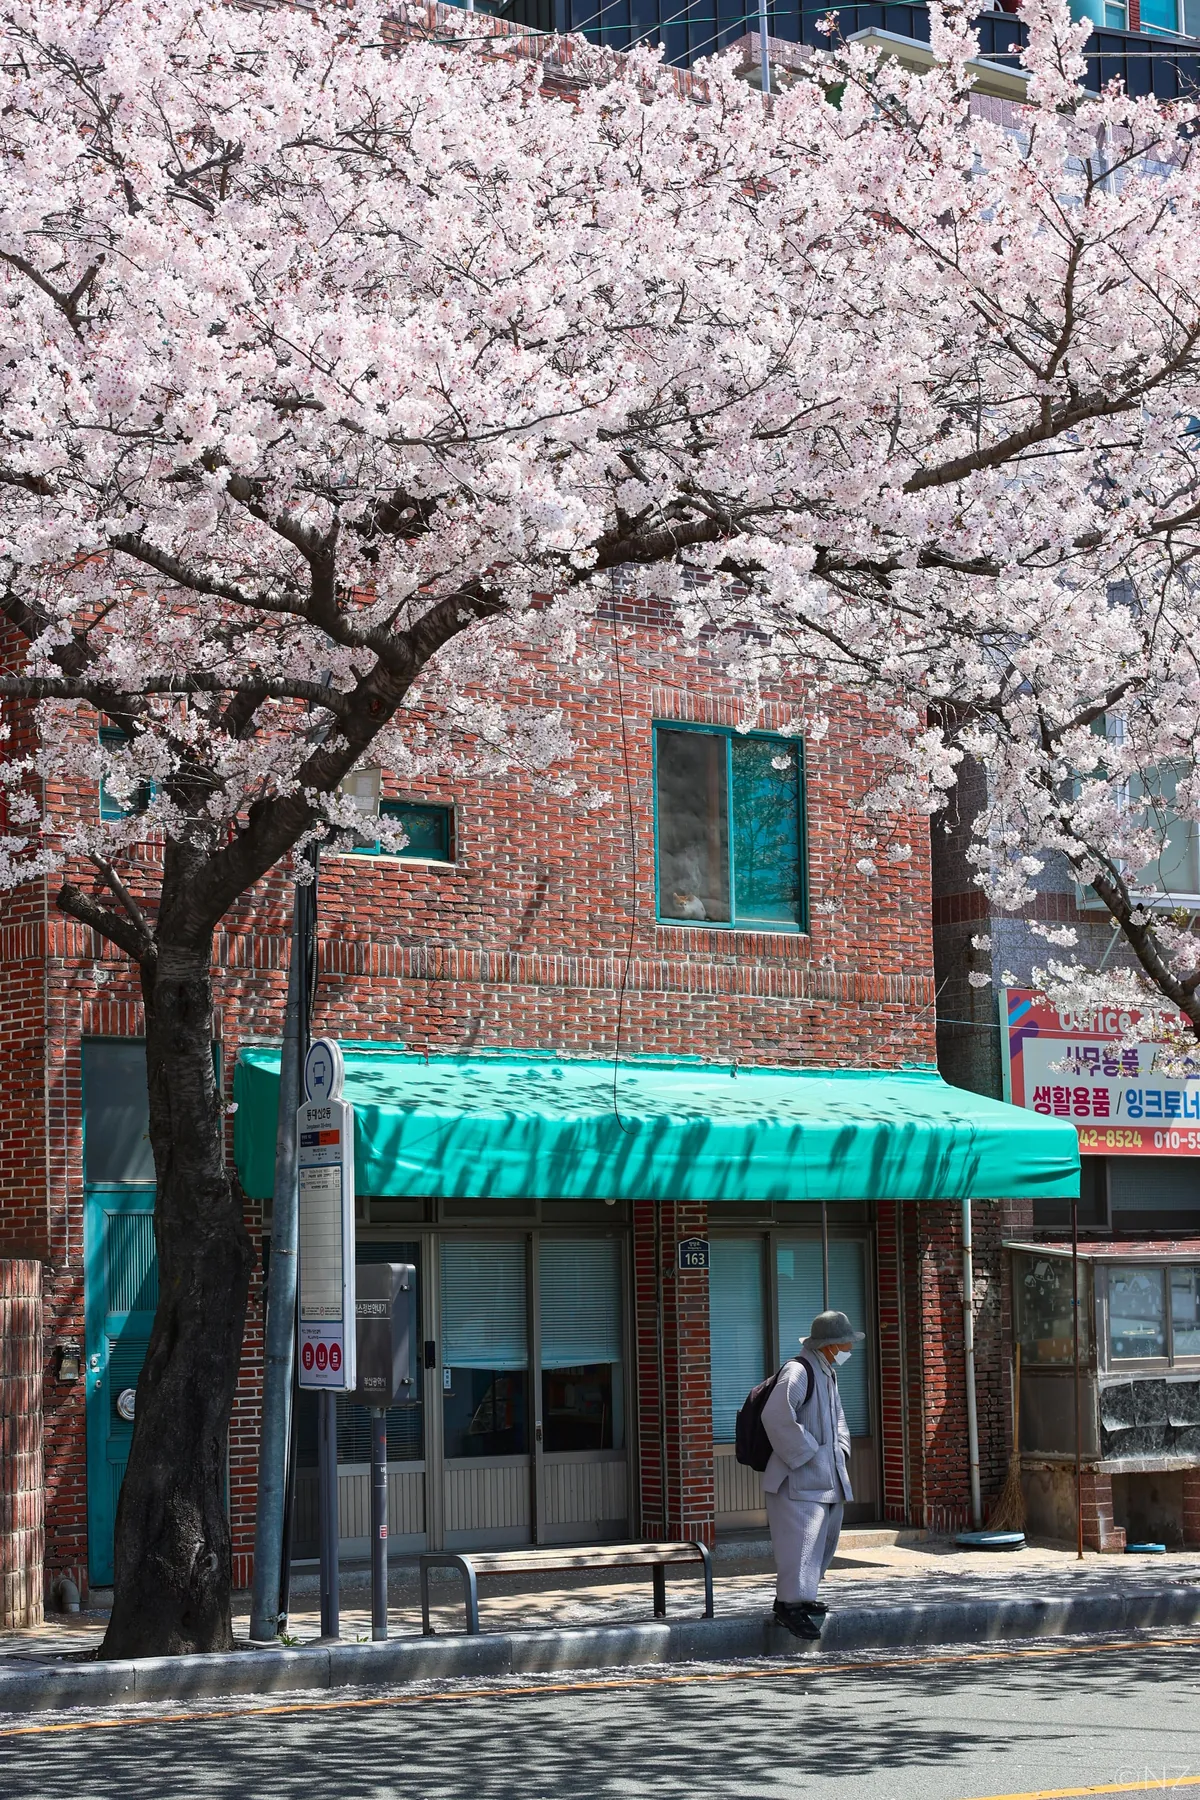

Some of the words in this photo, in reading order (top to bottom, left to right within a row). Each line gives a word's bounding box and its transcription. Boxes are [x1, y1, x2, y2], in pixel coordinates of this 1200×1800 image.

[1033, 1086, 1110, 1117] 생활용품
[1125, 1089, 1200, 1119] 잉크토너
[685, 1253, 705, 1265] 163
